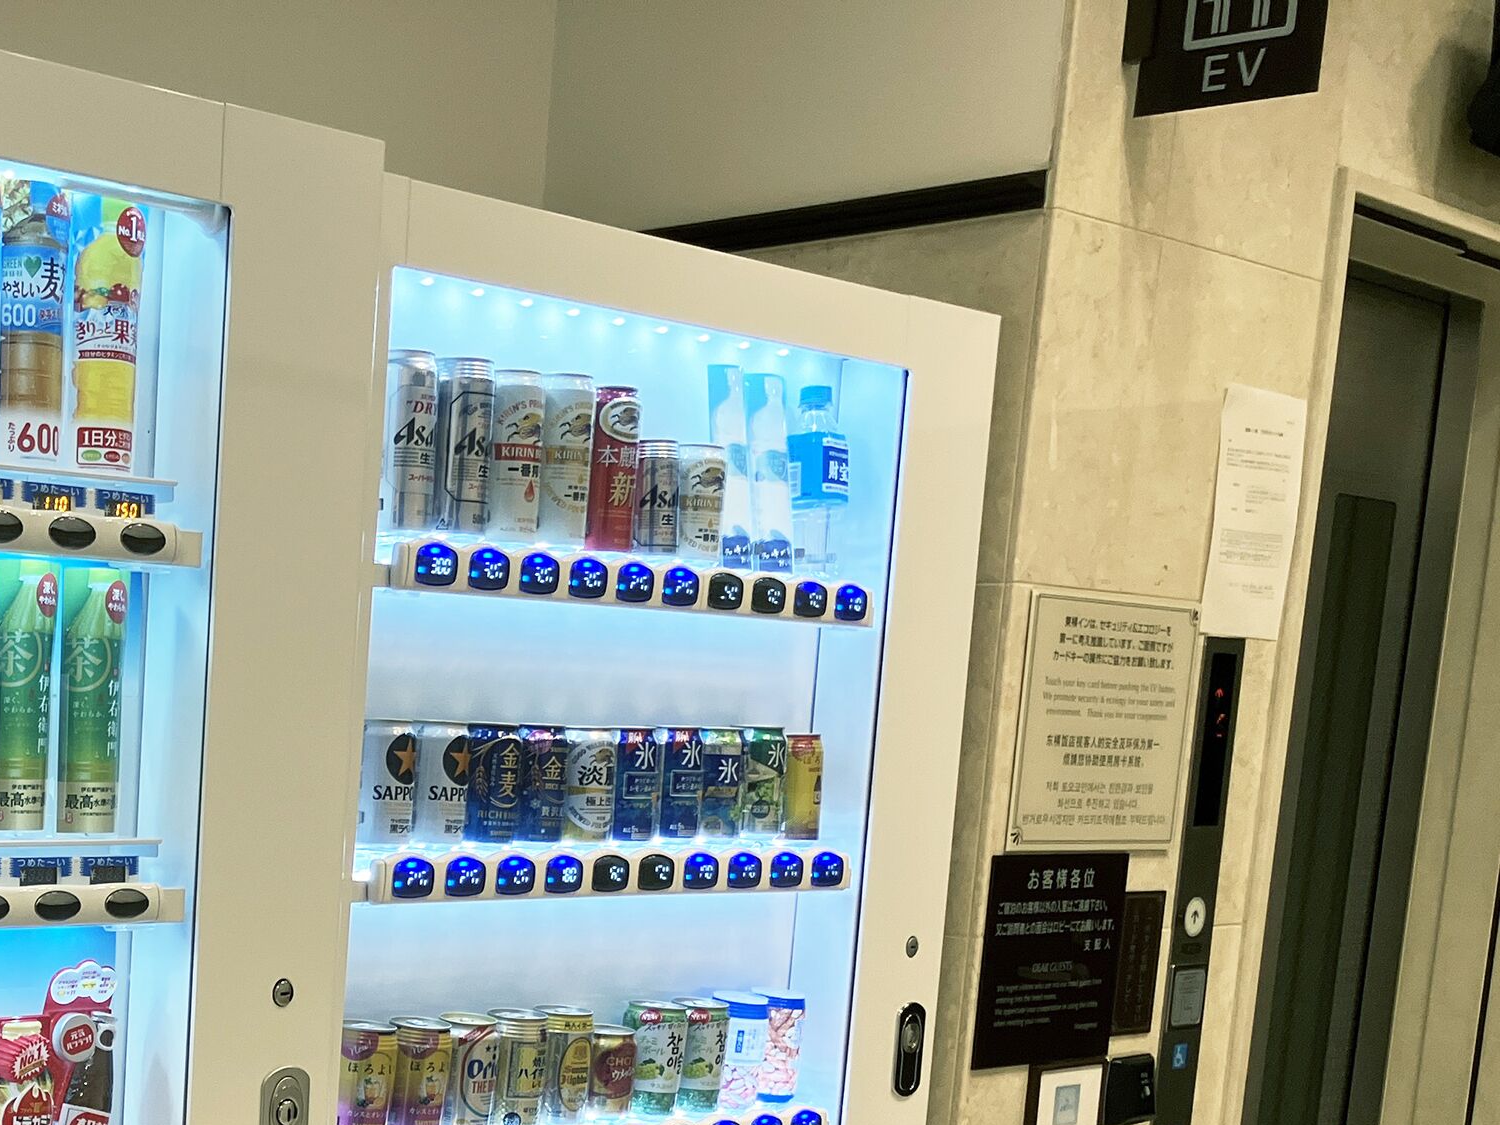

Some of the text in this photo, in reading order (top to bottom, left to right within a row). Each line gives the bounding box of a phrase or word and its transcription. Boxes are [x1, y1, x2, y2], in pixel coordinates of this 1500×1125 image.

[1202, 47, 1265, 93] EV
[2, 304, 37, 329] 600
[501, 446, 535, 459] KIRIN
[610, 471, 637, 508] 新
[65, 636, 103, 683] 茶
[499, 742, 520, 799] 金麦
[1027, 867, 1096, 890] お客様各位
[640, 1011, 659, 1022] NEW
[688, 1012, 709, 1023] NEW
[20, 1044, 43, 1070] No.1
